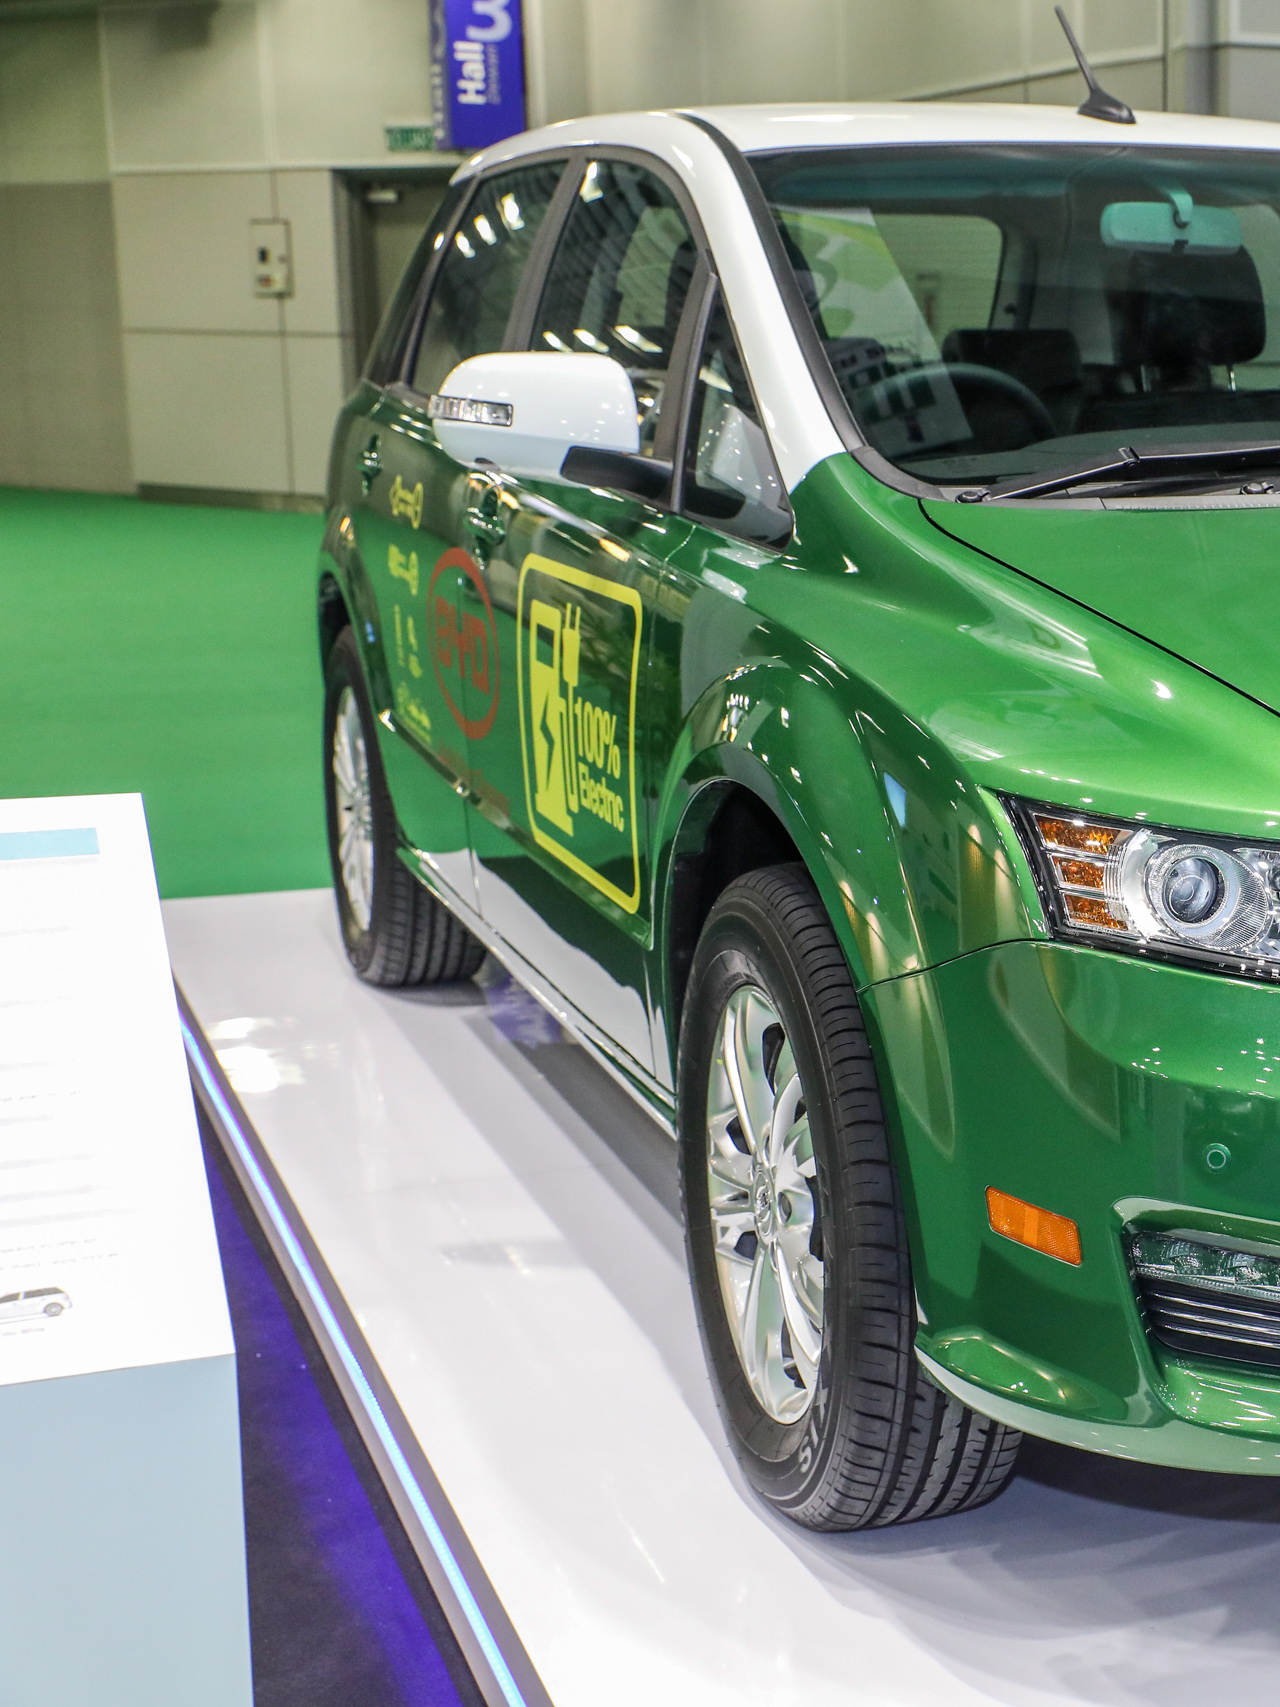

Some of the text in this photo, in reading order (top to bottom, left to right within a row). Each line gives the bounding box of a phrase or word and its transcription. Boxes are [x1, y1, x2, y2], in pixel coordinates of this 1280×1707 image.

[453, 41, 487, 104] Hall
[435, 596, 490, 694] BYD
[575, 697, 622, 779] 100%
[578, 763, 625, 832] Electric
